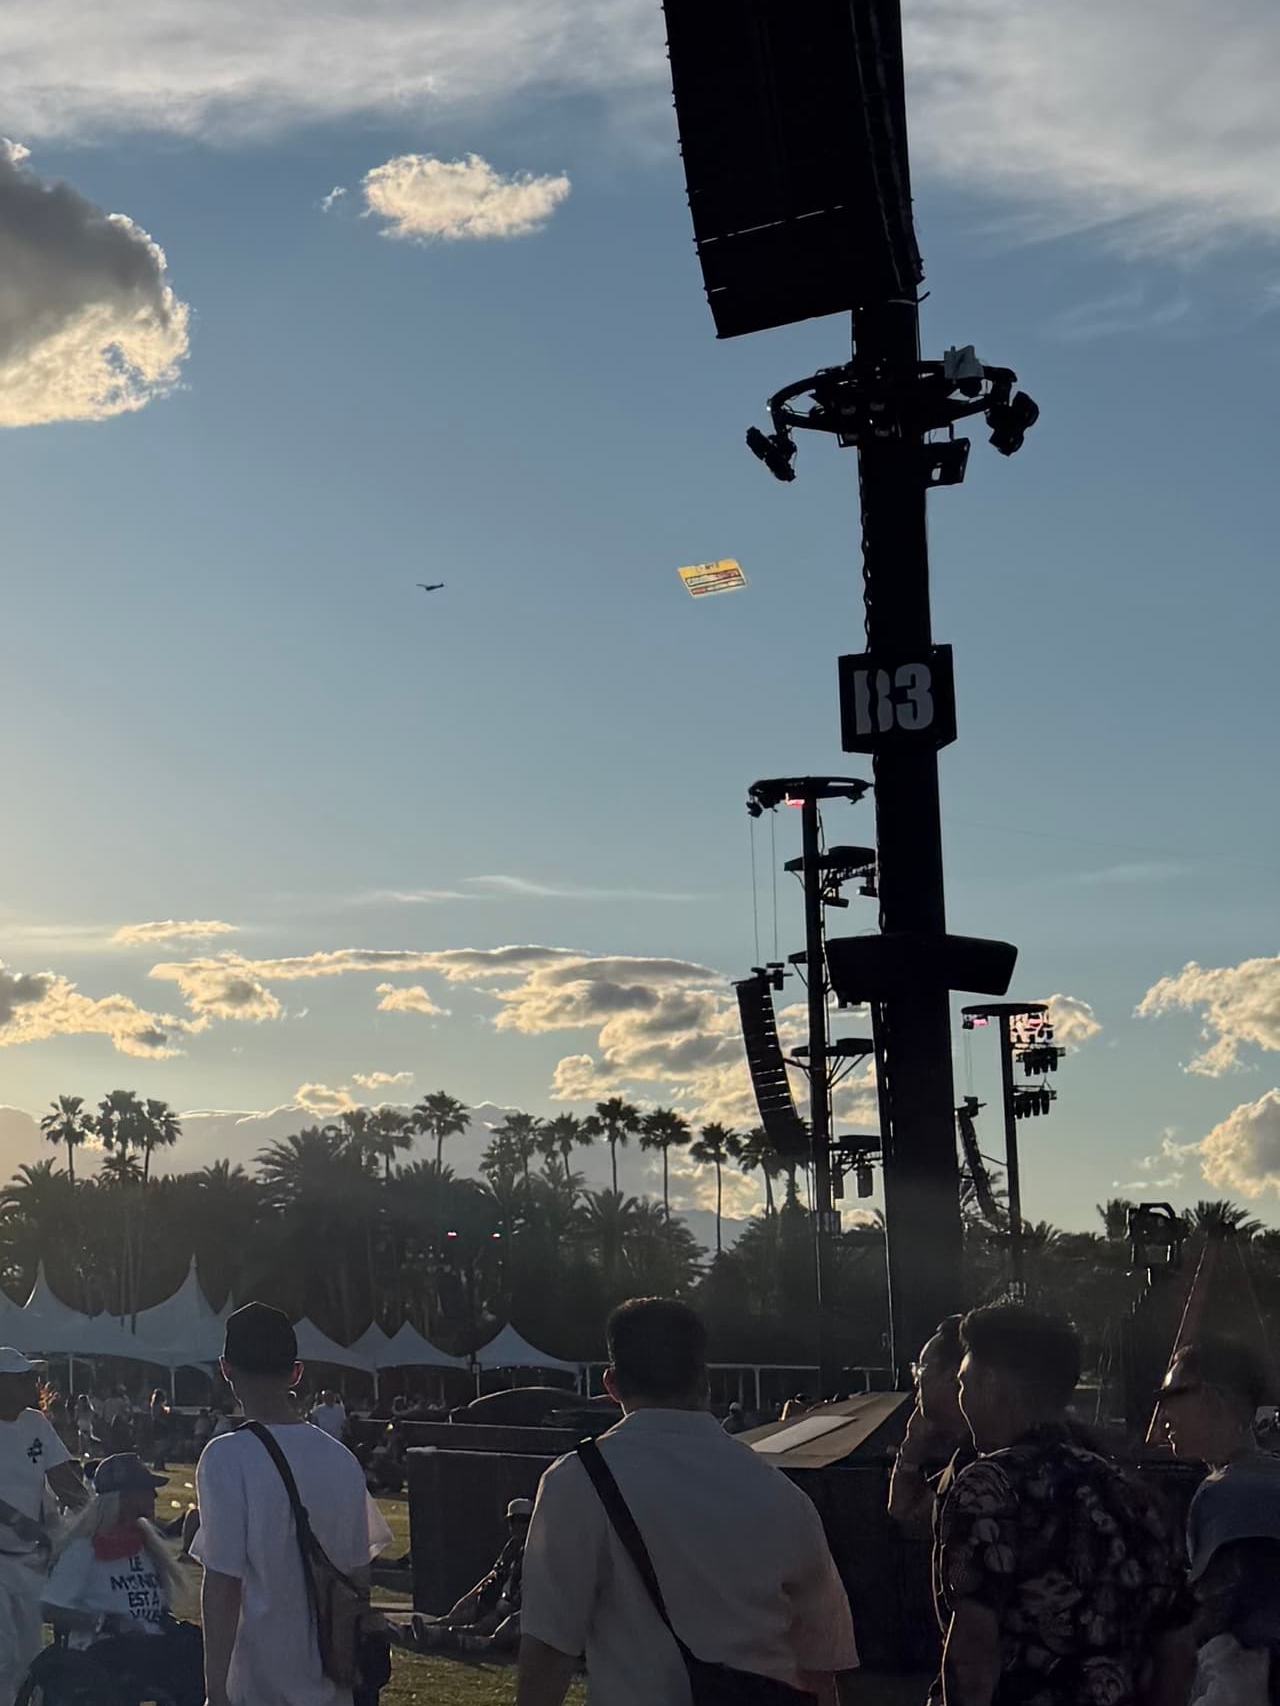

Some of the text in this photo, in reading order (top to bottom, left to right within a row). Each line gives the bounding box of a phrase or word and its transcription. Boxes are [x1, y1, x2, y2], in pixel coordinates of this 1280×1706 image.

[129, 1556, 144, 1571] LE
[110, 1573, 161, 1590] MOND
[128, 1591, 150, 1607] EST
